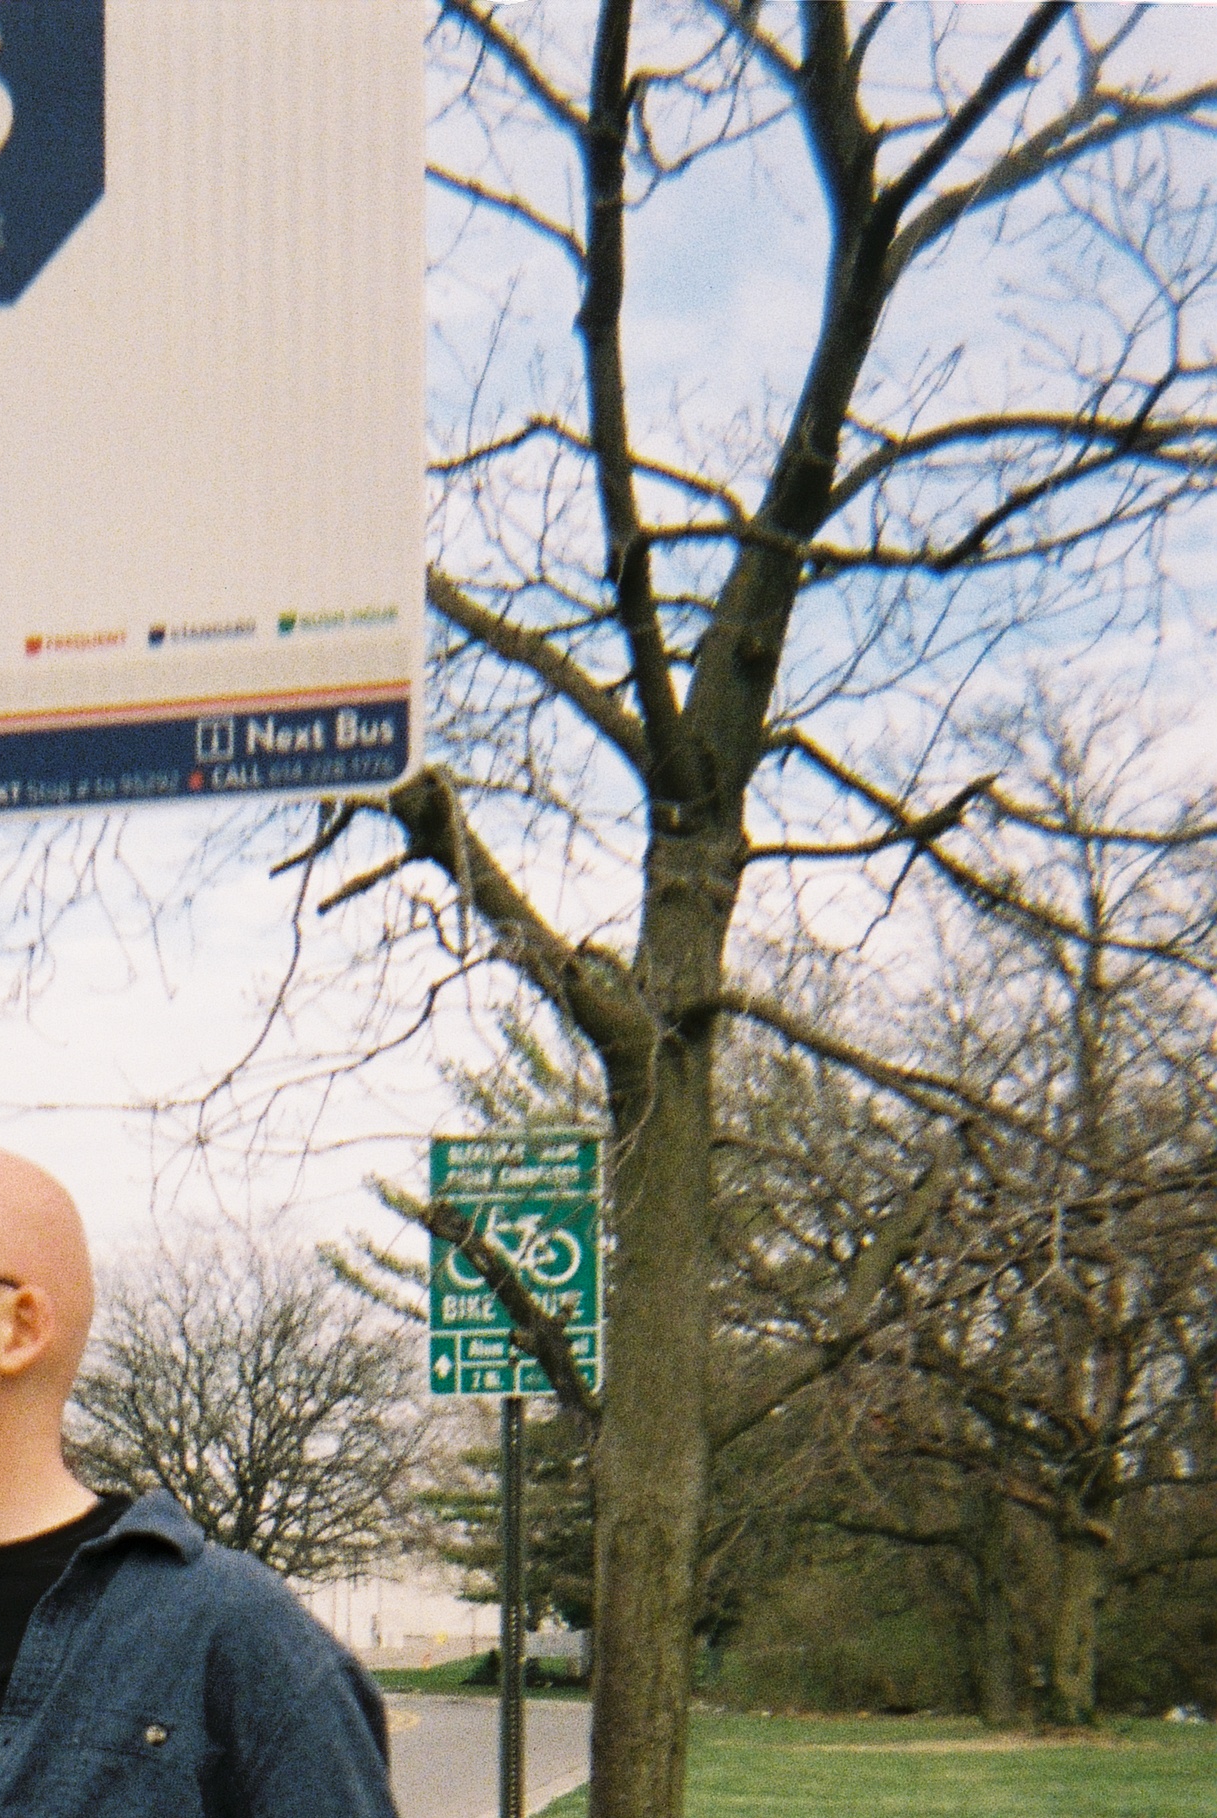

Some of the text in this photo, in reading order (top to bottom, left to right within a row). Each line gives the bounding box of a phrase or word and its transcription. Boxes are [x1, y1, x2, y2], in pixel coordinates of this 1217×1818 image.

[245, 707, 395, 754] Next Bus
[212, 762, 261, 790] CALL
[442, 1293, 497, 1325] BIKE
